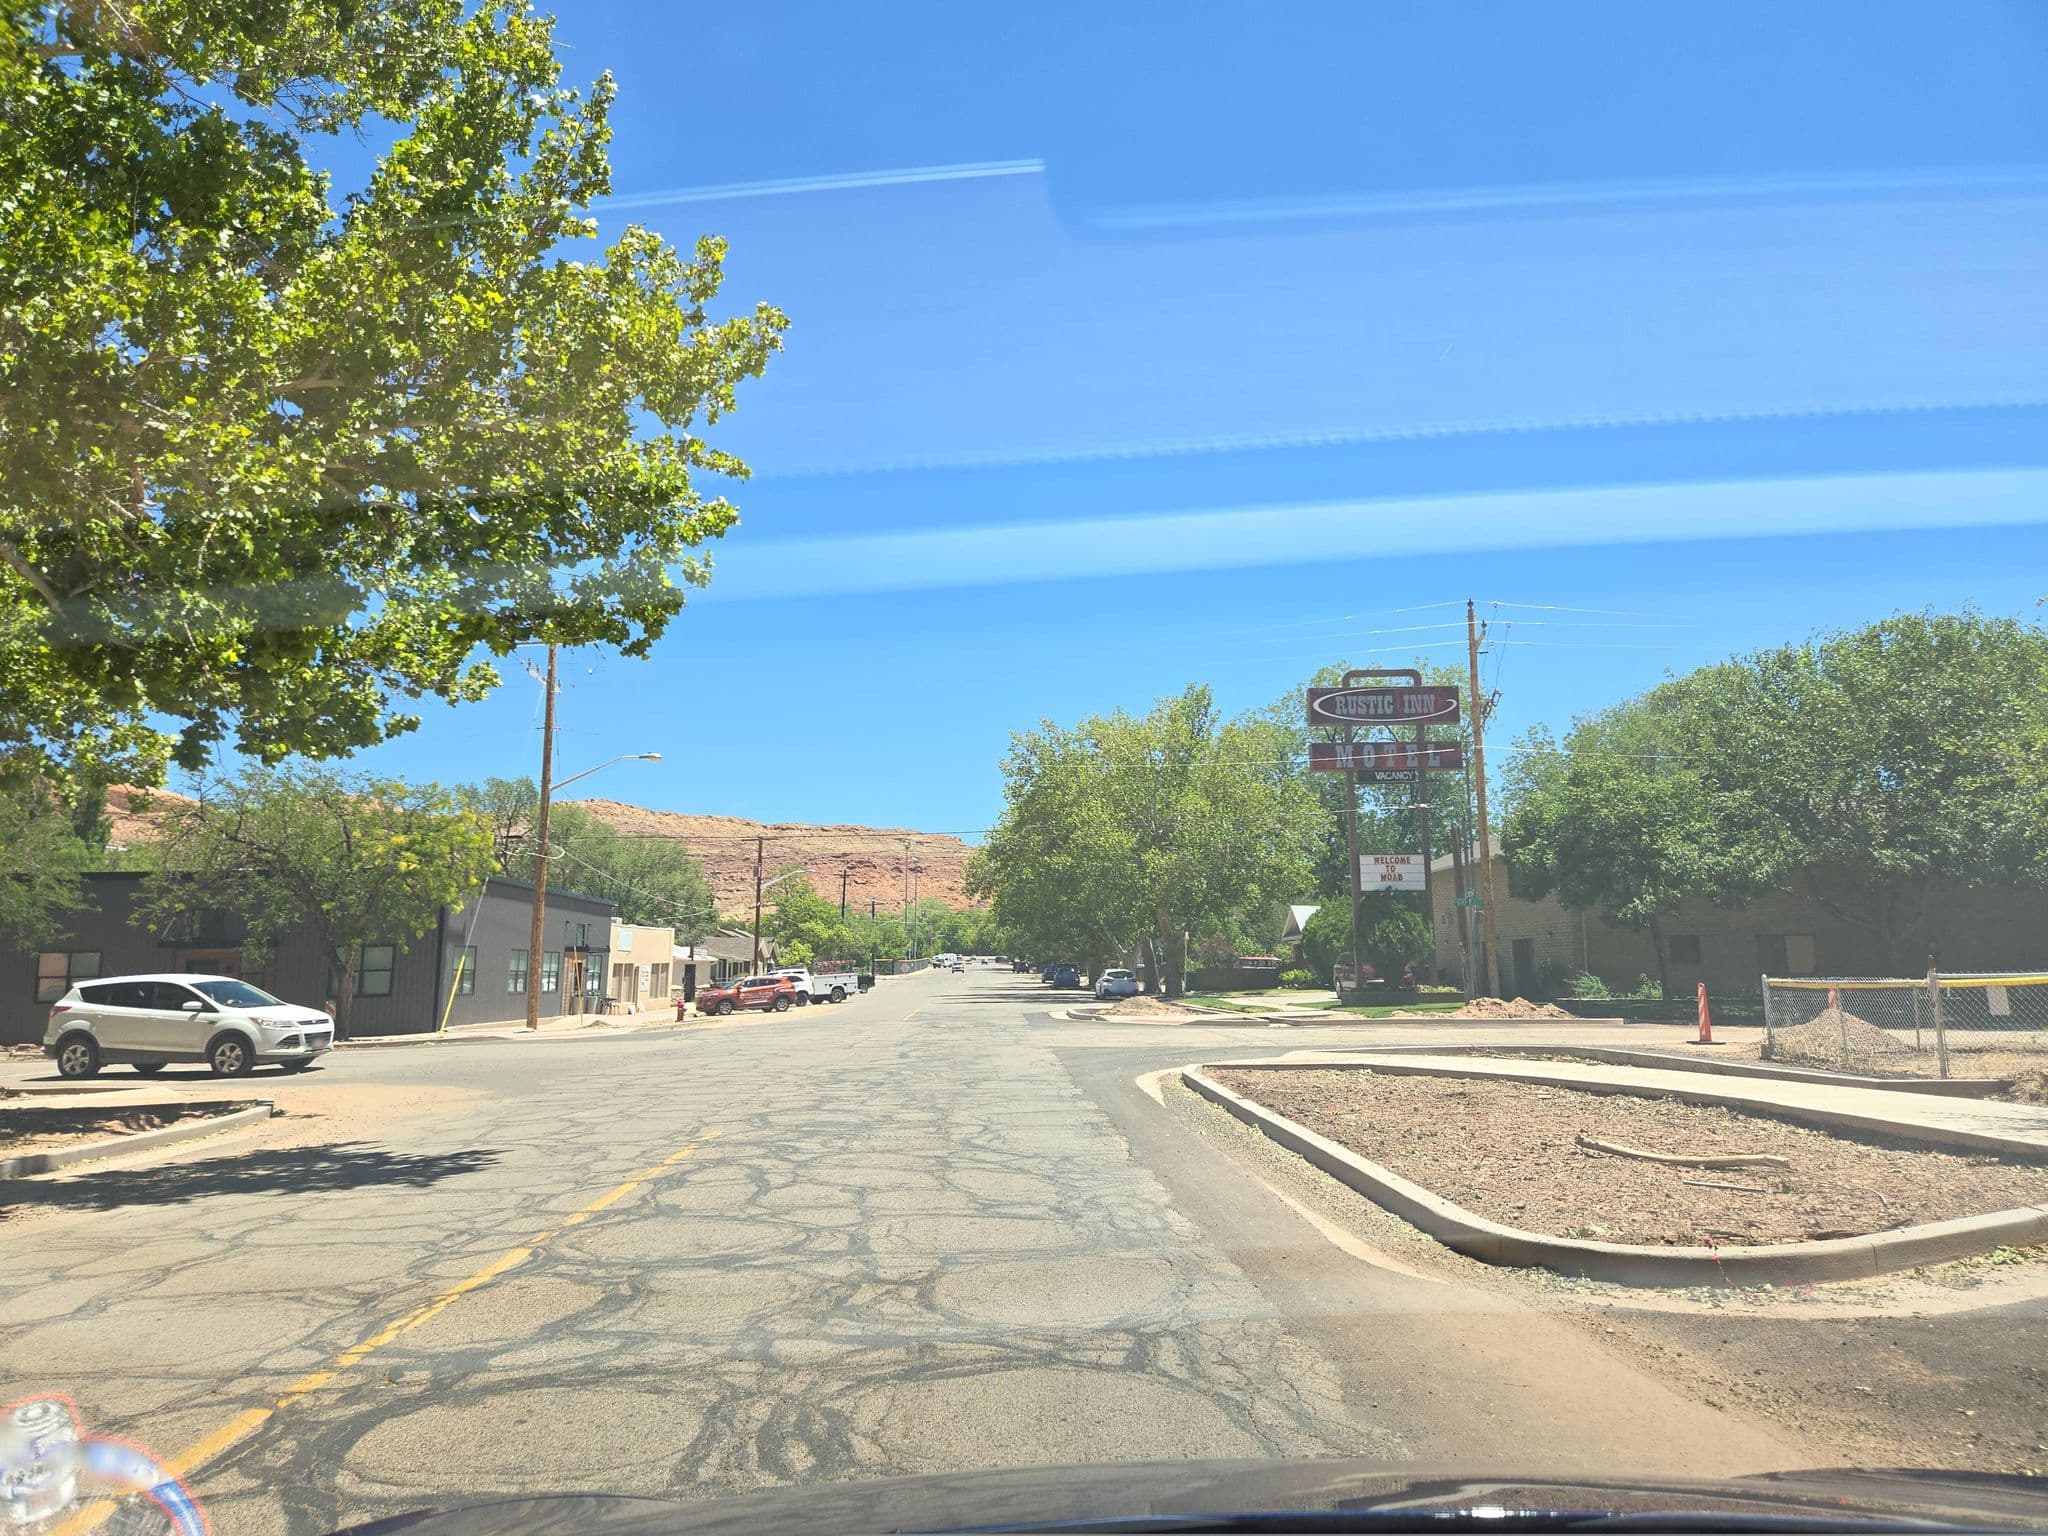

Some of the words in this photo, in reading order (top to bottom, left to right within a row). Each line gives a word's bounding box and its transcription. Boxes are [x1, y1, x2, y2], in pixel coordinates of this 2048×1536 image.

[1335, 695, 1393, 715] RUSTIC
[1403, 694, 1435, 714] INN
[1336, 744, 1440, 768] MOTEL
[1375, 771, 1414, 780] VACANCY
[1374, 856, 1412, 864] WELCOME
[1385, 865, 1396, 873] TO
[1381, 873, 1403, 881] MOAB
